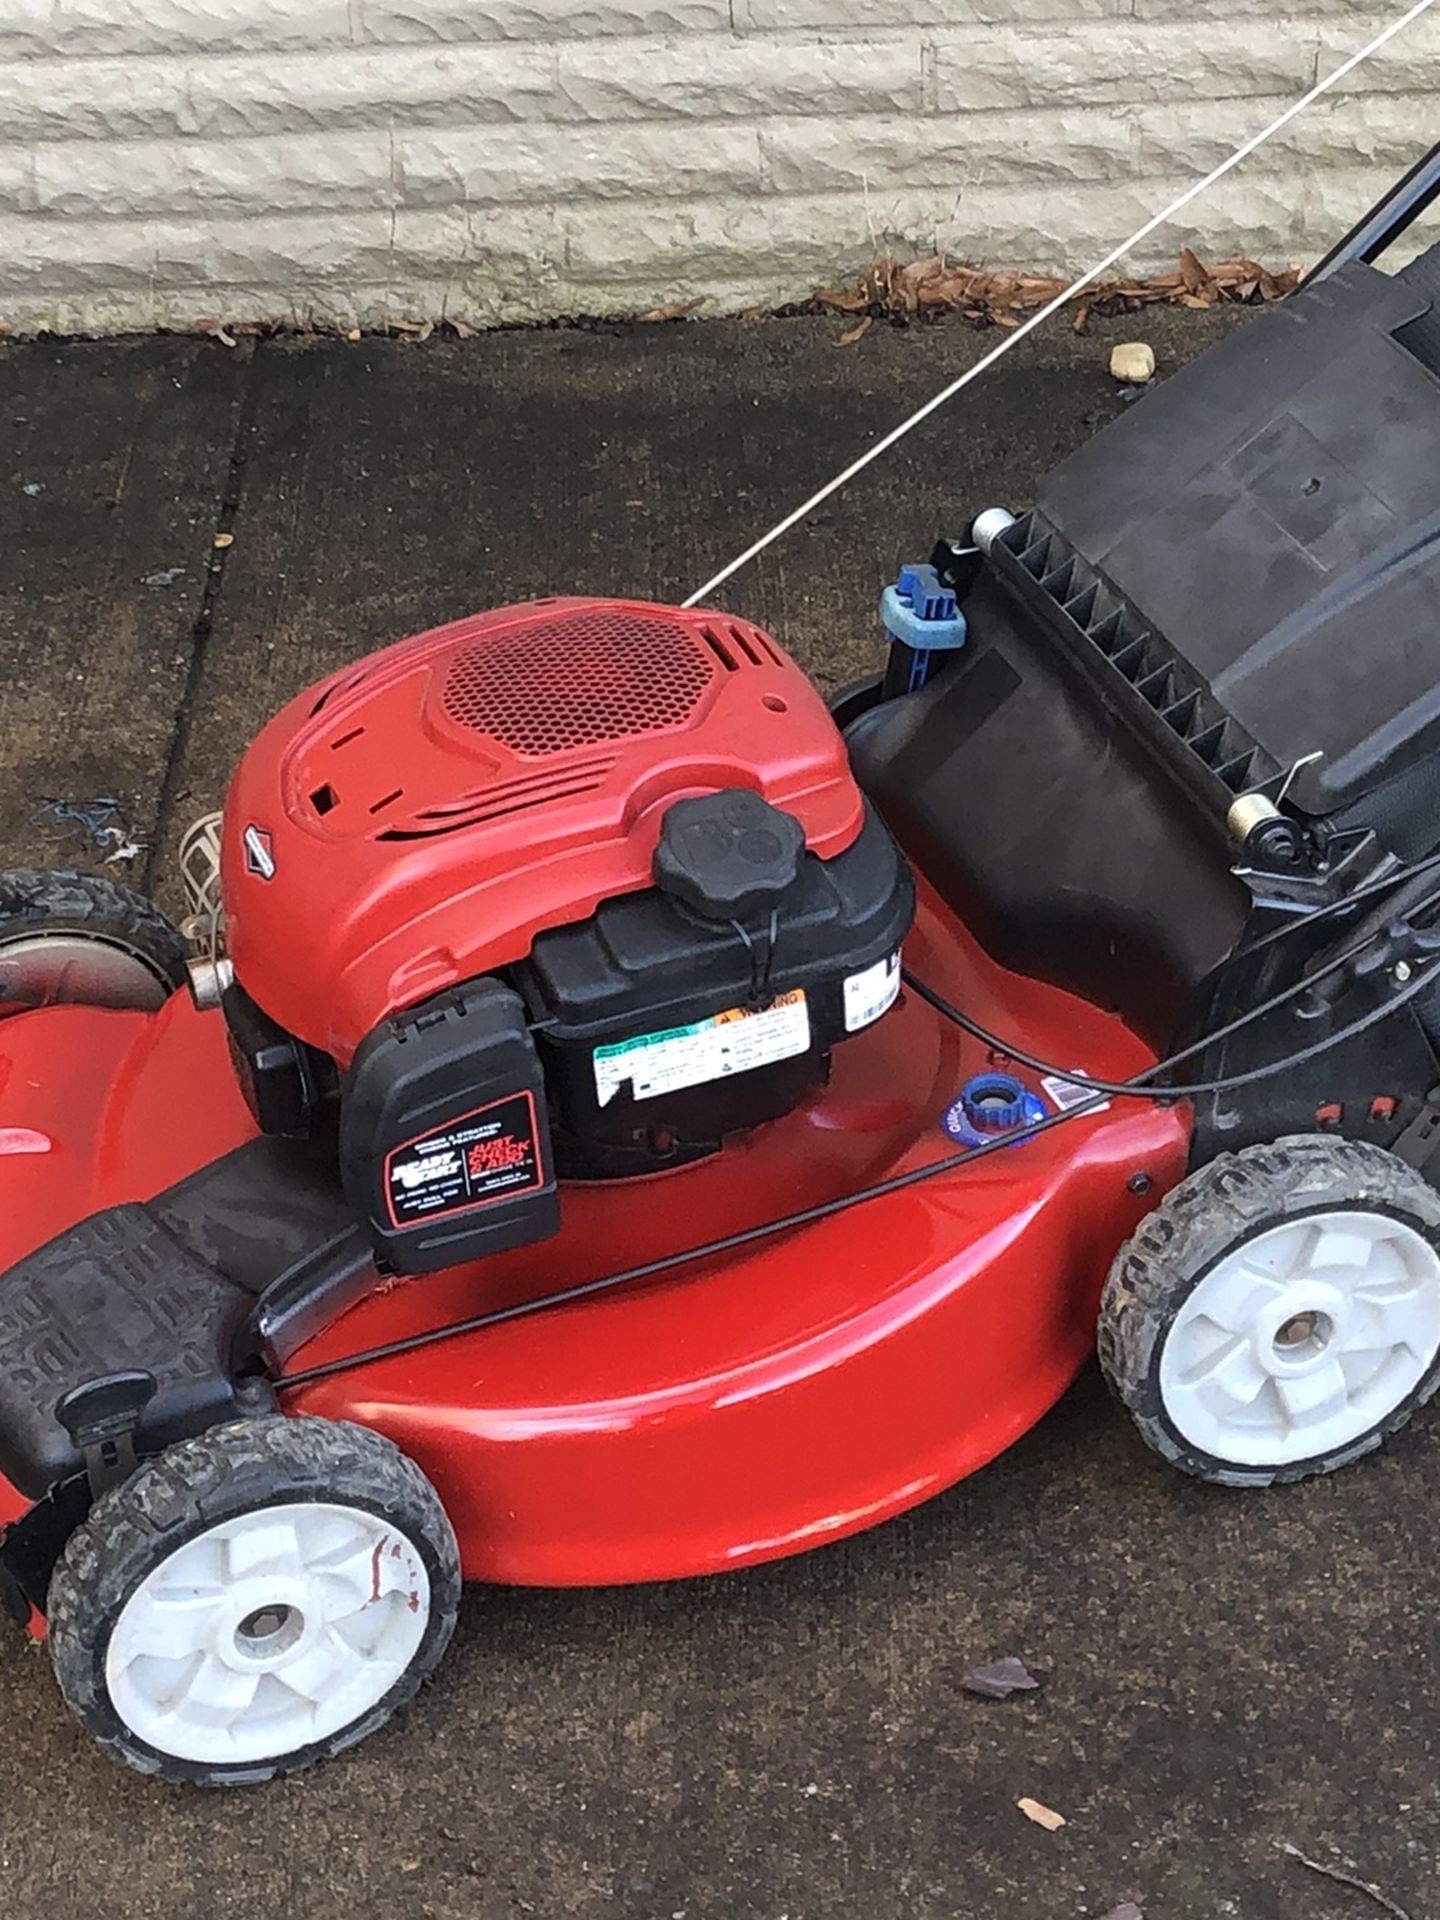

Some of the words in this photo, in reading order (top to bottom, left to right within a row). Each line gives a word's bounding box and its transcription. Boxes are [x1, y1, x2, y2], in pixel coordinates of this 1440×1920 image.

[468, 1134, 515, 1156] JUST
[469, 1139, 531, 1165] CHECK
[391, 1151, 455, 1182] READY
[486, 1151, 525, 1171] ADD
